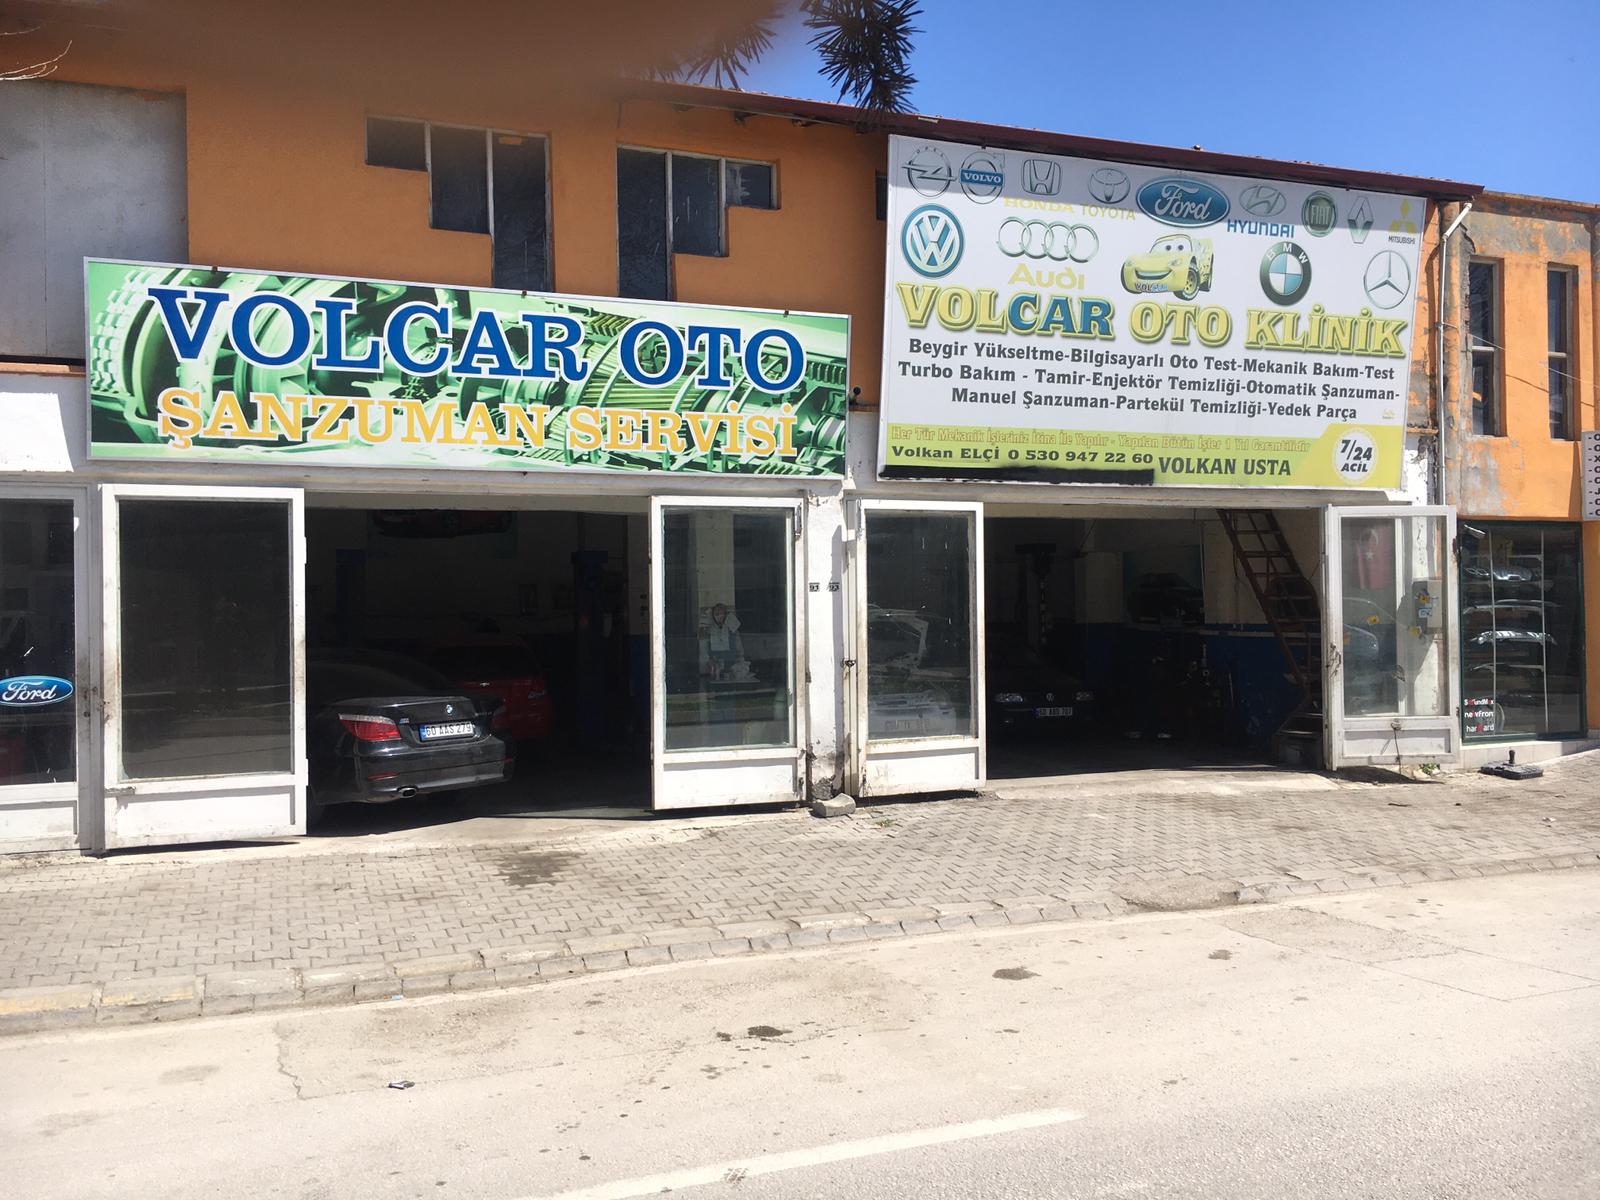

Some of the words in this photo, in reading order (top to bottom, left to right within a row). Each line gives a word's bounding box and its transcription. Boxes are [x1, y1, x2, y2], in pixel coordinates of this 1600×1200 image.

[963, 172, 1002, 184] VOLVO
[1004, 196, 1075, 213] HONDA
[1081, 204, 1138, 220] TOYOTA
[1155, 183, 1213, 221] Ford
[1310, 204, 1332, 226] FIAT
[1227, 219, 1295, 239] HYUNDAI
[1388, 235, 1416, 245] MITSUBISHI
[1267, 242, 1309, 264] BMW
[1008, 263, 1086, 290] Audi
[897, 283, 1115, 341] VOLCAR
[1129, 301, 1232, 347] OTO
[1245, 304, 1408, 358] KLİNİK
[147, 287, 589, 380] VOLCAR
[619, 320, 805, 391] OTO
[909, 338, 968, 359] Beygir
[974, 342, 1164, 369] Yükseltme-Bilgisayarlı
[1169, 354, 1198, 370] Oto
[1203, 356, 1308, 375] Test-Mekanik
[1313, 364, 1395, 380] Bakım-Test
[898, 361, 953, 378] Turbo
[960, 365, 1016, 382] Bakım
[1035, 369, 1163, 390] Tamir-Enjektör
[1168, 376, 1317, 397] Temizliği-Otomatik
[1321, 383, 1400, 401] Şanzuman-
[952, 388, 1017, 405] Manuel
[1022, 391, 1185, 412] Şanzuman-Partekül
[1190, 398, 1311, 418] Temizliği-Yedek
[1316, 404, 1357, 422] Parça
[159, 388, 549, 449] ŞANZUMAN
[568, 402, 797, 456] SERVİSİ
[892, 426, 912, 441] Her
[915, 427, 935, 441] Tür
[938, 429, 984, 443] Mekanik
[1162, 436, 1194, 450] Bütün
[891, 445, 953, 459] Volkan
[960, 446, 1000, 463] ELÇİ
[1008, 449, 1019, 460] 0
[1025, 450, 1059, 461] 530
[1065, 451, 1098, 463] 947
[1104, 452, 1126, 464] 22
[1132, 453, 1153, 464] 60
[1340, 439, 1373, 461] 7/24
[1158, 456, 1236, 476] VOLKAN
[1243, 458, 1292, 476] USTA
[1340, 461, 1368, 472] ACİL
[2, 681, 57, 702] Ford
[426, 726, 437, 737] 60
[440, 724, 454, 736] AAS
[457, 722, 472, 733] 279
